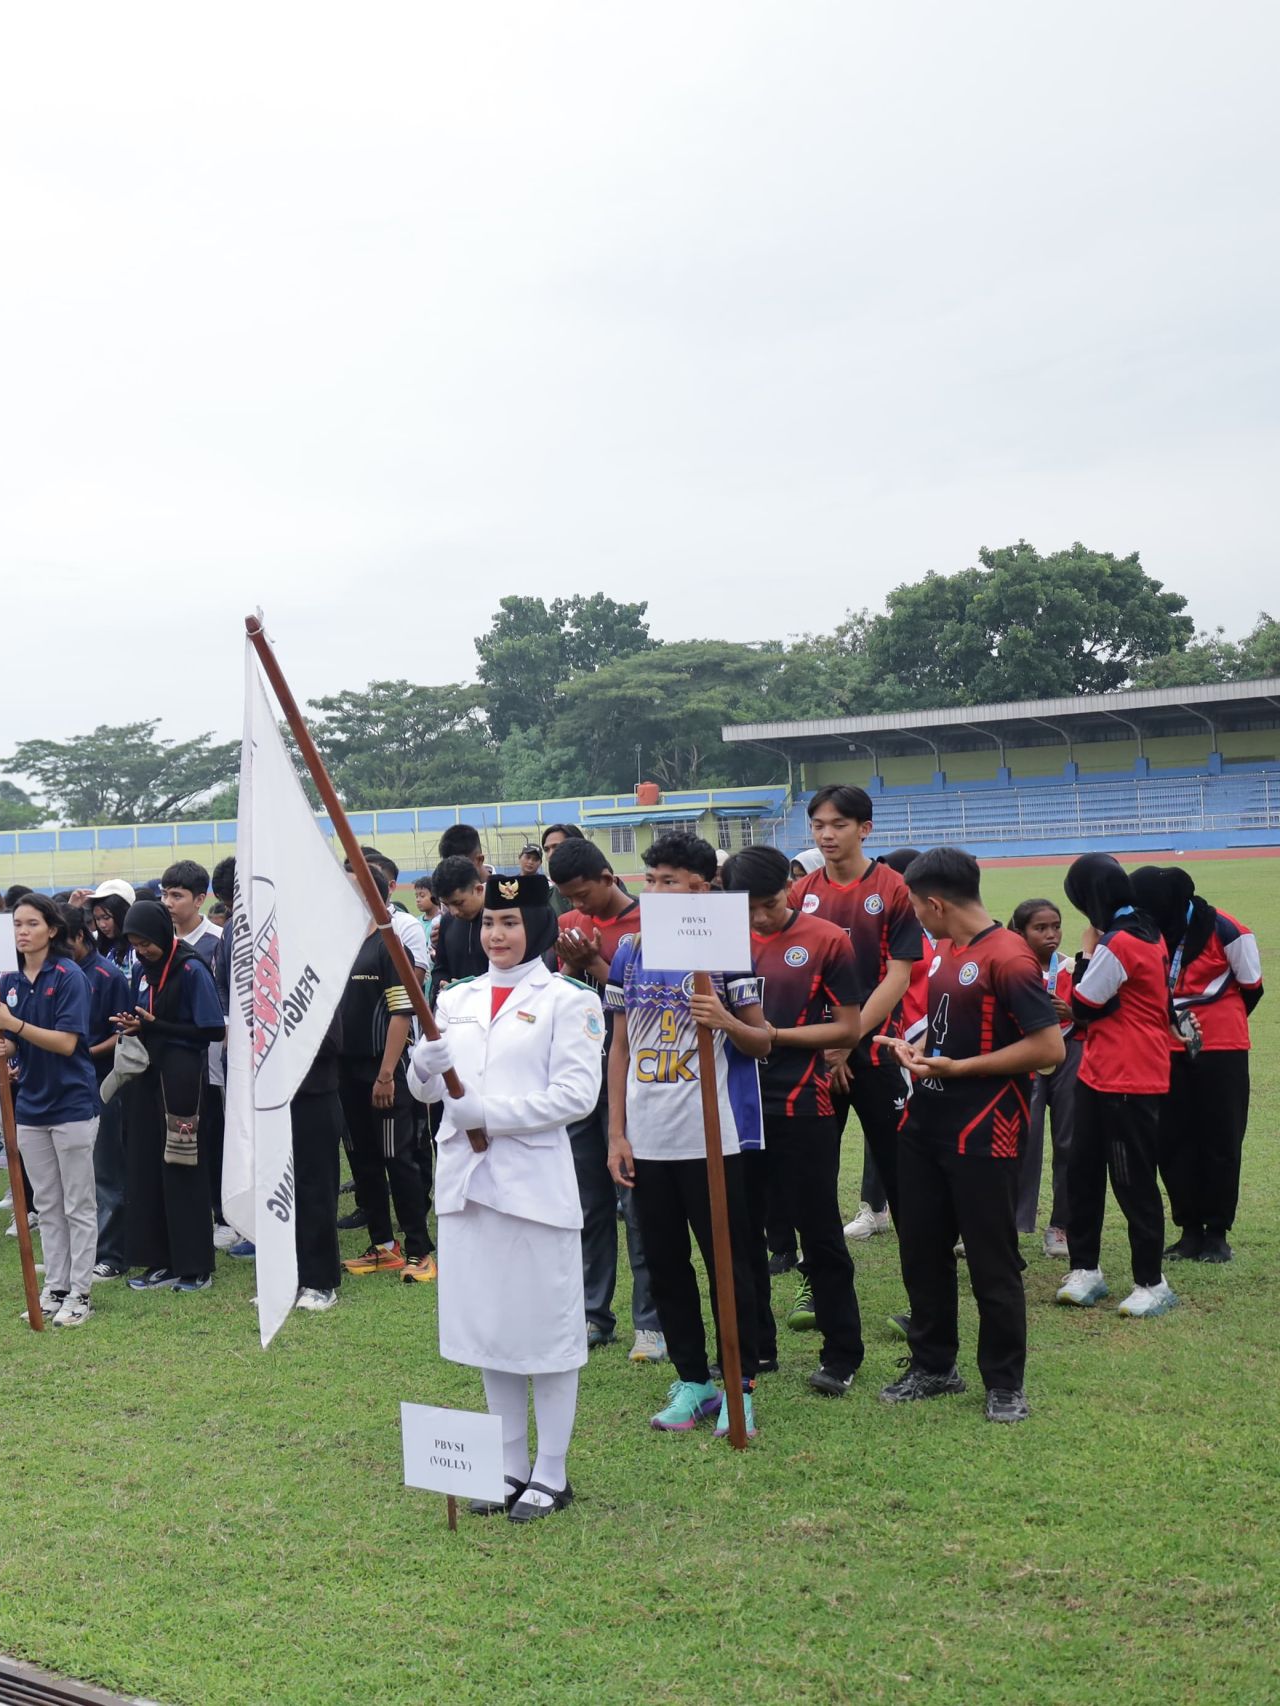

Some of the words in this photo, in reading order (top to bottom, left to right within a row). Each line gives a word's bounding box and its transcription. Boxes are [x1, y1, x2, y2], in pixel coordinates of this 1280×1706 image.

[681, 916, 707, 924] PBVSI
[677, 928, 712, 936] (VOLLY)
[661, 1009, 677, 1044] 9
[932, 992, 950, 1045] 4
[636, 1048, 700, 1083] CIK
[434, 1439, 465, 1453] PBVSI
[429, 1455, 472, 1473] (VOLLY)
